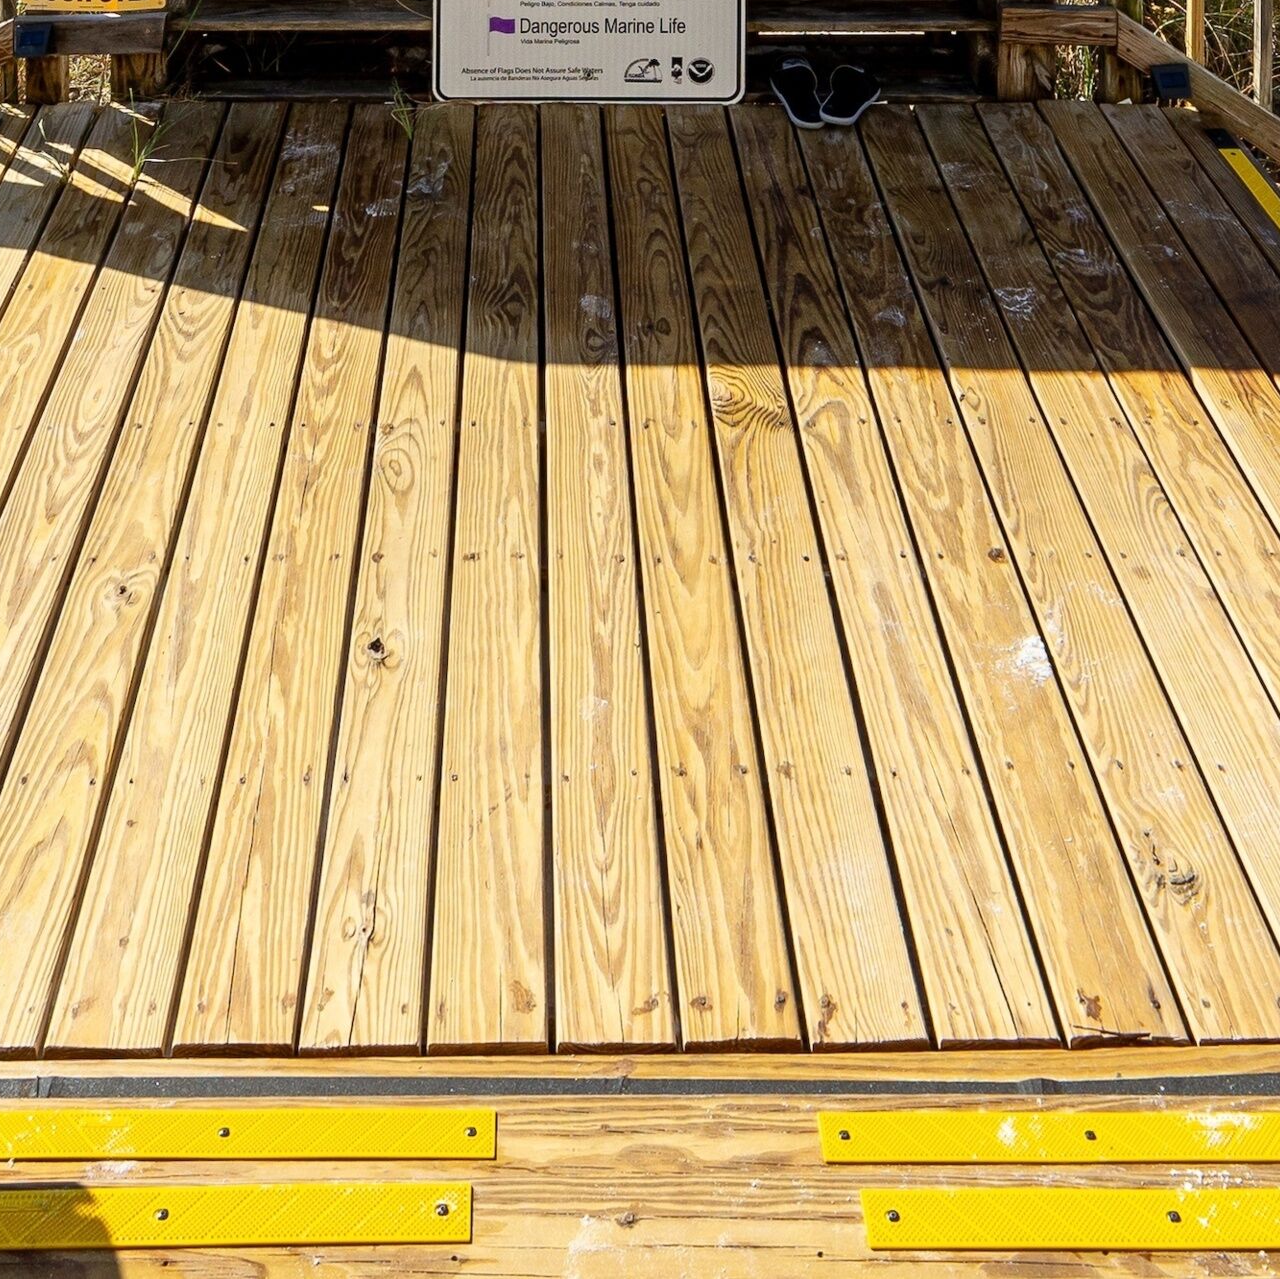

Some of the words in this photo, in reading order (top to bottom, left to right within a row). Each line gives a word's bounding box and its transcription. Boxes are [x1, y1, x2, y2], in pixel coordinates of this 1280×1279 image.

[520, 18, 599, 37] Dangerous
[605, 18, 654, 33] Marine
[660, 18, 686, 33] Life
